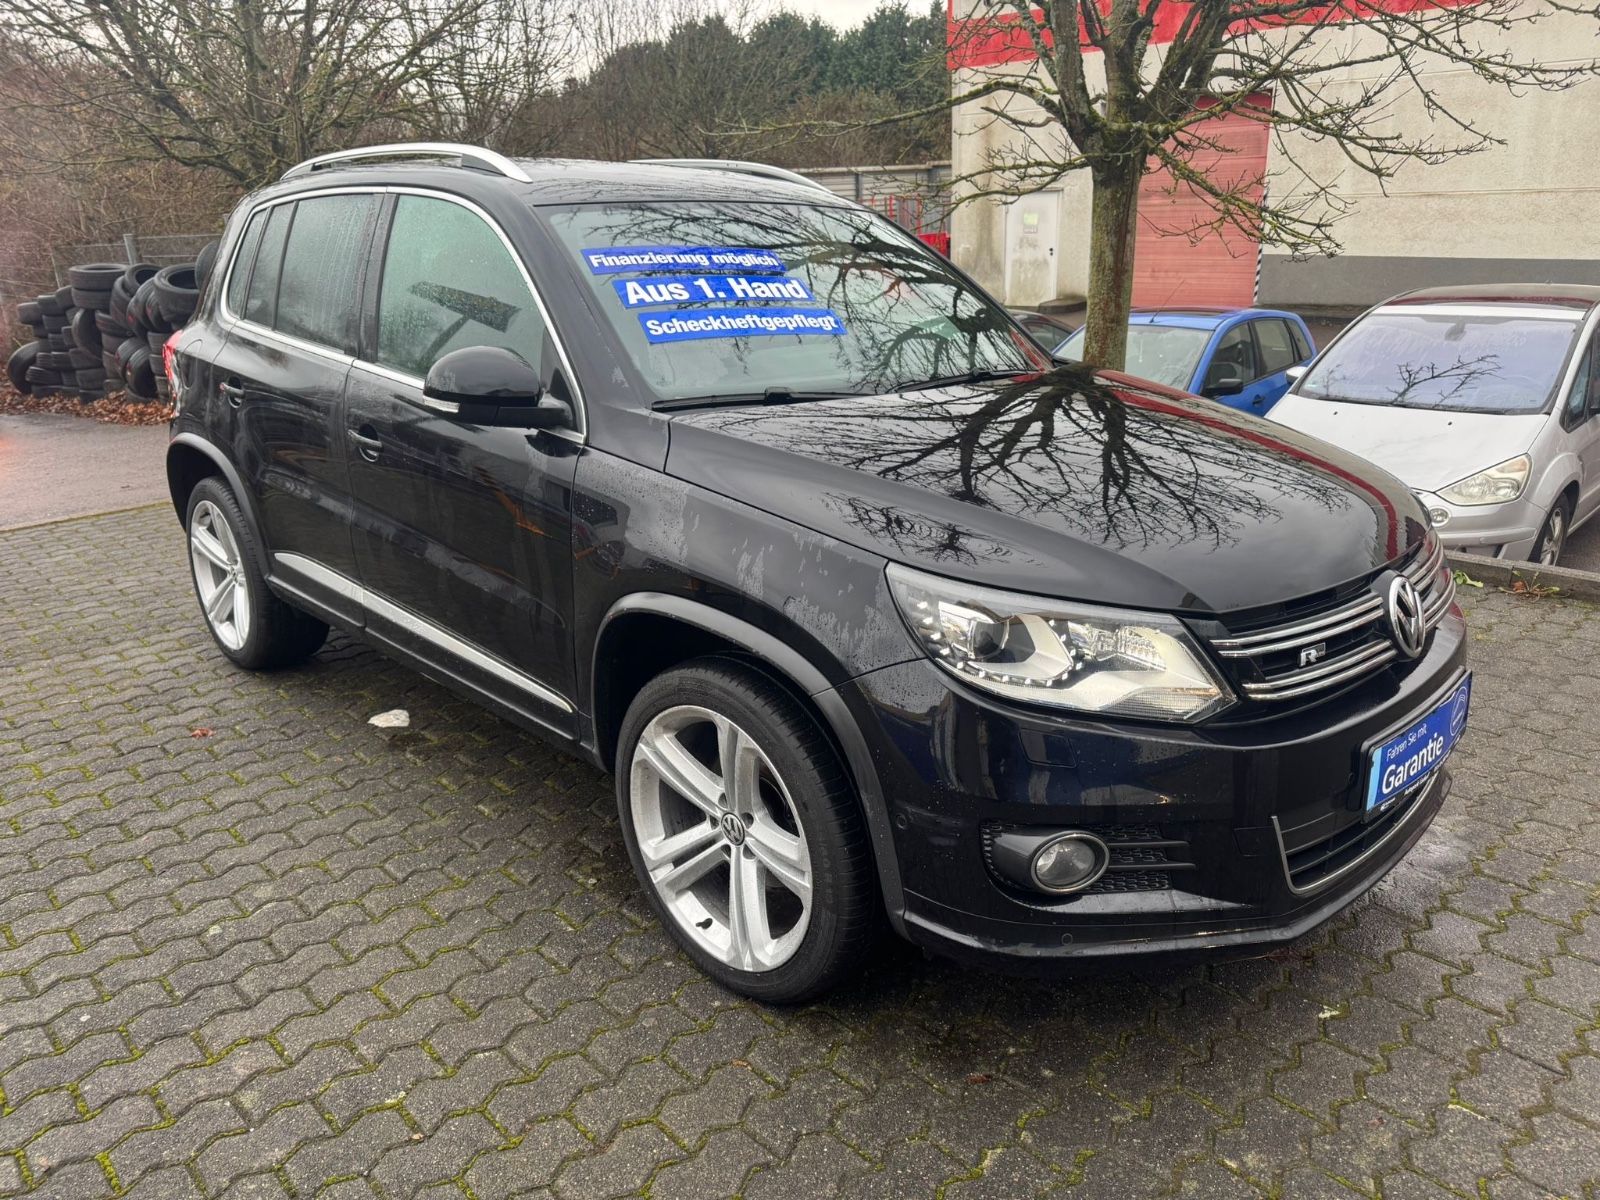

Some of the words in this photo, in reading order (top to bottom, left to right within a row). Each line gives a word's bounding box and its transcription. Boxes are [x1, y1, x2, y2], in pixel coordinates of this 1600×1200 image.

[589, 252, 706, 268] Finanzierung
[711, 253, 780, 268] möglich
[625, 280, 690, 304] Aus
[693, 278, 726, 299] 1.
[730, 277, 809, 299] Hand
[645, 314, 838, 336] Scheckheftgepflegt
[1386, 740, 1407, 762] Fahren
[1407, 731, 1417, 746] Sie
[1381, 732, 1444, 795] Garantie
